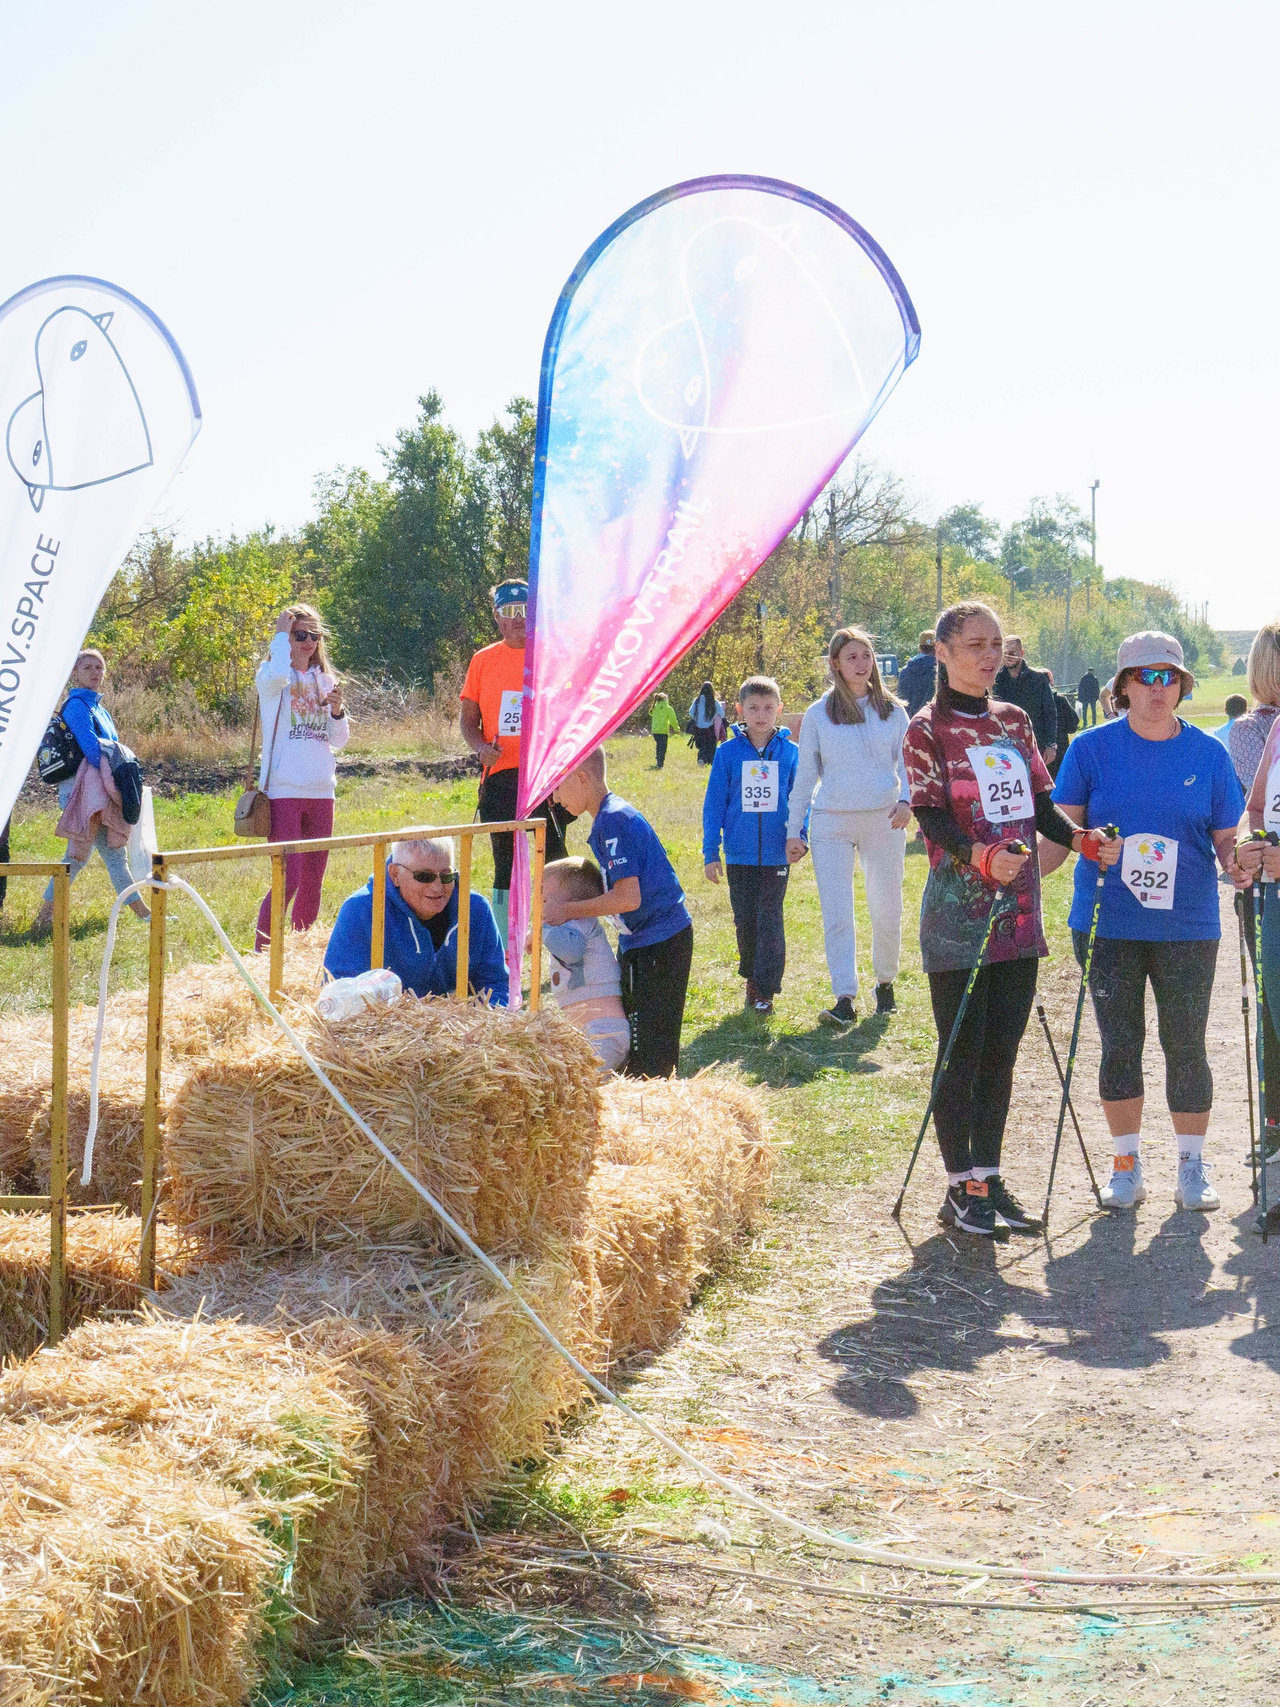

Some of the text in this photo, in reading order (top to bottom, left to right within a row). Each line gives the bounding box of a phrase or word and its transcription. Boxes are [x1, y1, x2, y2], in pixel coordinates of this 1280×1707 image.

[503, 712, 522, 724] 25
[744, 786, 771, 799] 335
[988, 779, 1025, 802] 254
[605, 837, 618, 857] 7
[1130, 870, 1169, 889] 252
